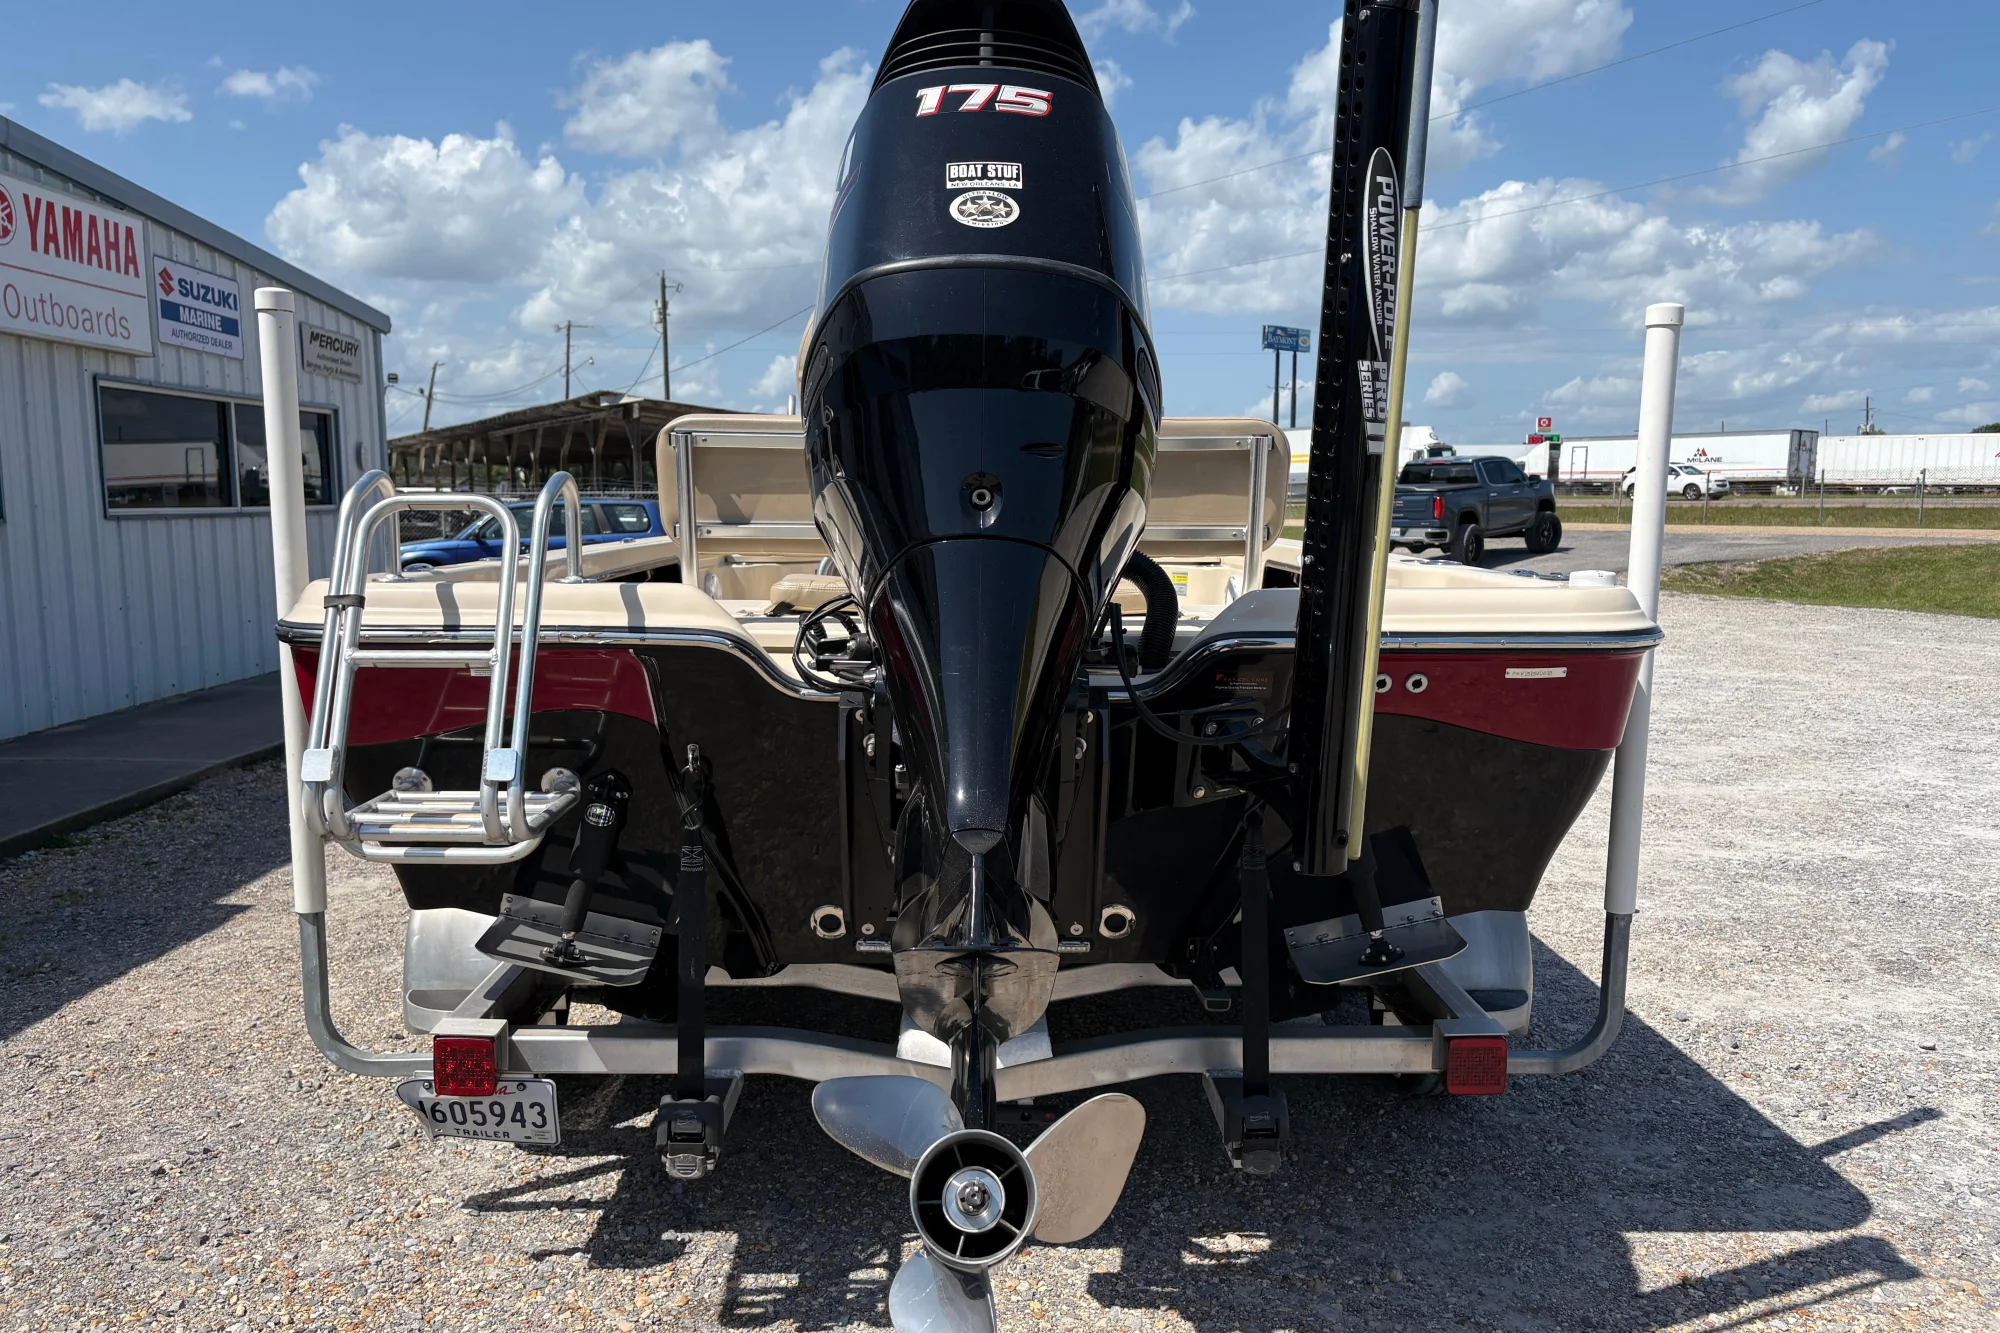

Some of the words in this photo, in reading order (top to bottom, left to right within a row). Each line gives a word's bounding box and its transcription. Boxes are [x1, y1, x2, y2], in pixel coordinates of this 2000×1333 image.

[915, 83, 1054, 117] 175
[949, 164, 983, 179] BOAT
[987, 164, 1019, 179] STUF
[22, 192, 140, 279] YAMAHA
[1368, 206, 1380, 252] SHALLOW
[1371, 254, 1382, 286] WATER
[1375, 175, 1397, 351] POWER-POLE
[3, 283, 131, 341] Outboards
[178, 277, 238, 312] SUZUKI
[1374, 288, 1384, 326] ANCHOR
[179, 305, 223, 332] MARINE
[171, 328, 210, 345] AUTHORIZED
[210, 336, 233, 351] DEALER
[310, 331, 358, 357] MERCURY
[1359, 360, 1376, 420] SERIES
[1373, 361, 1388, 420] PRO
[453, 1127, 511, 1139] TRAILER
